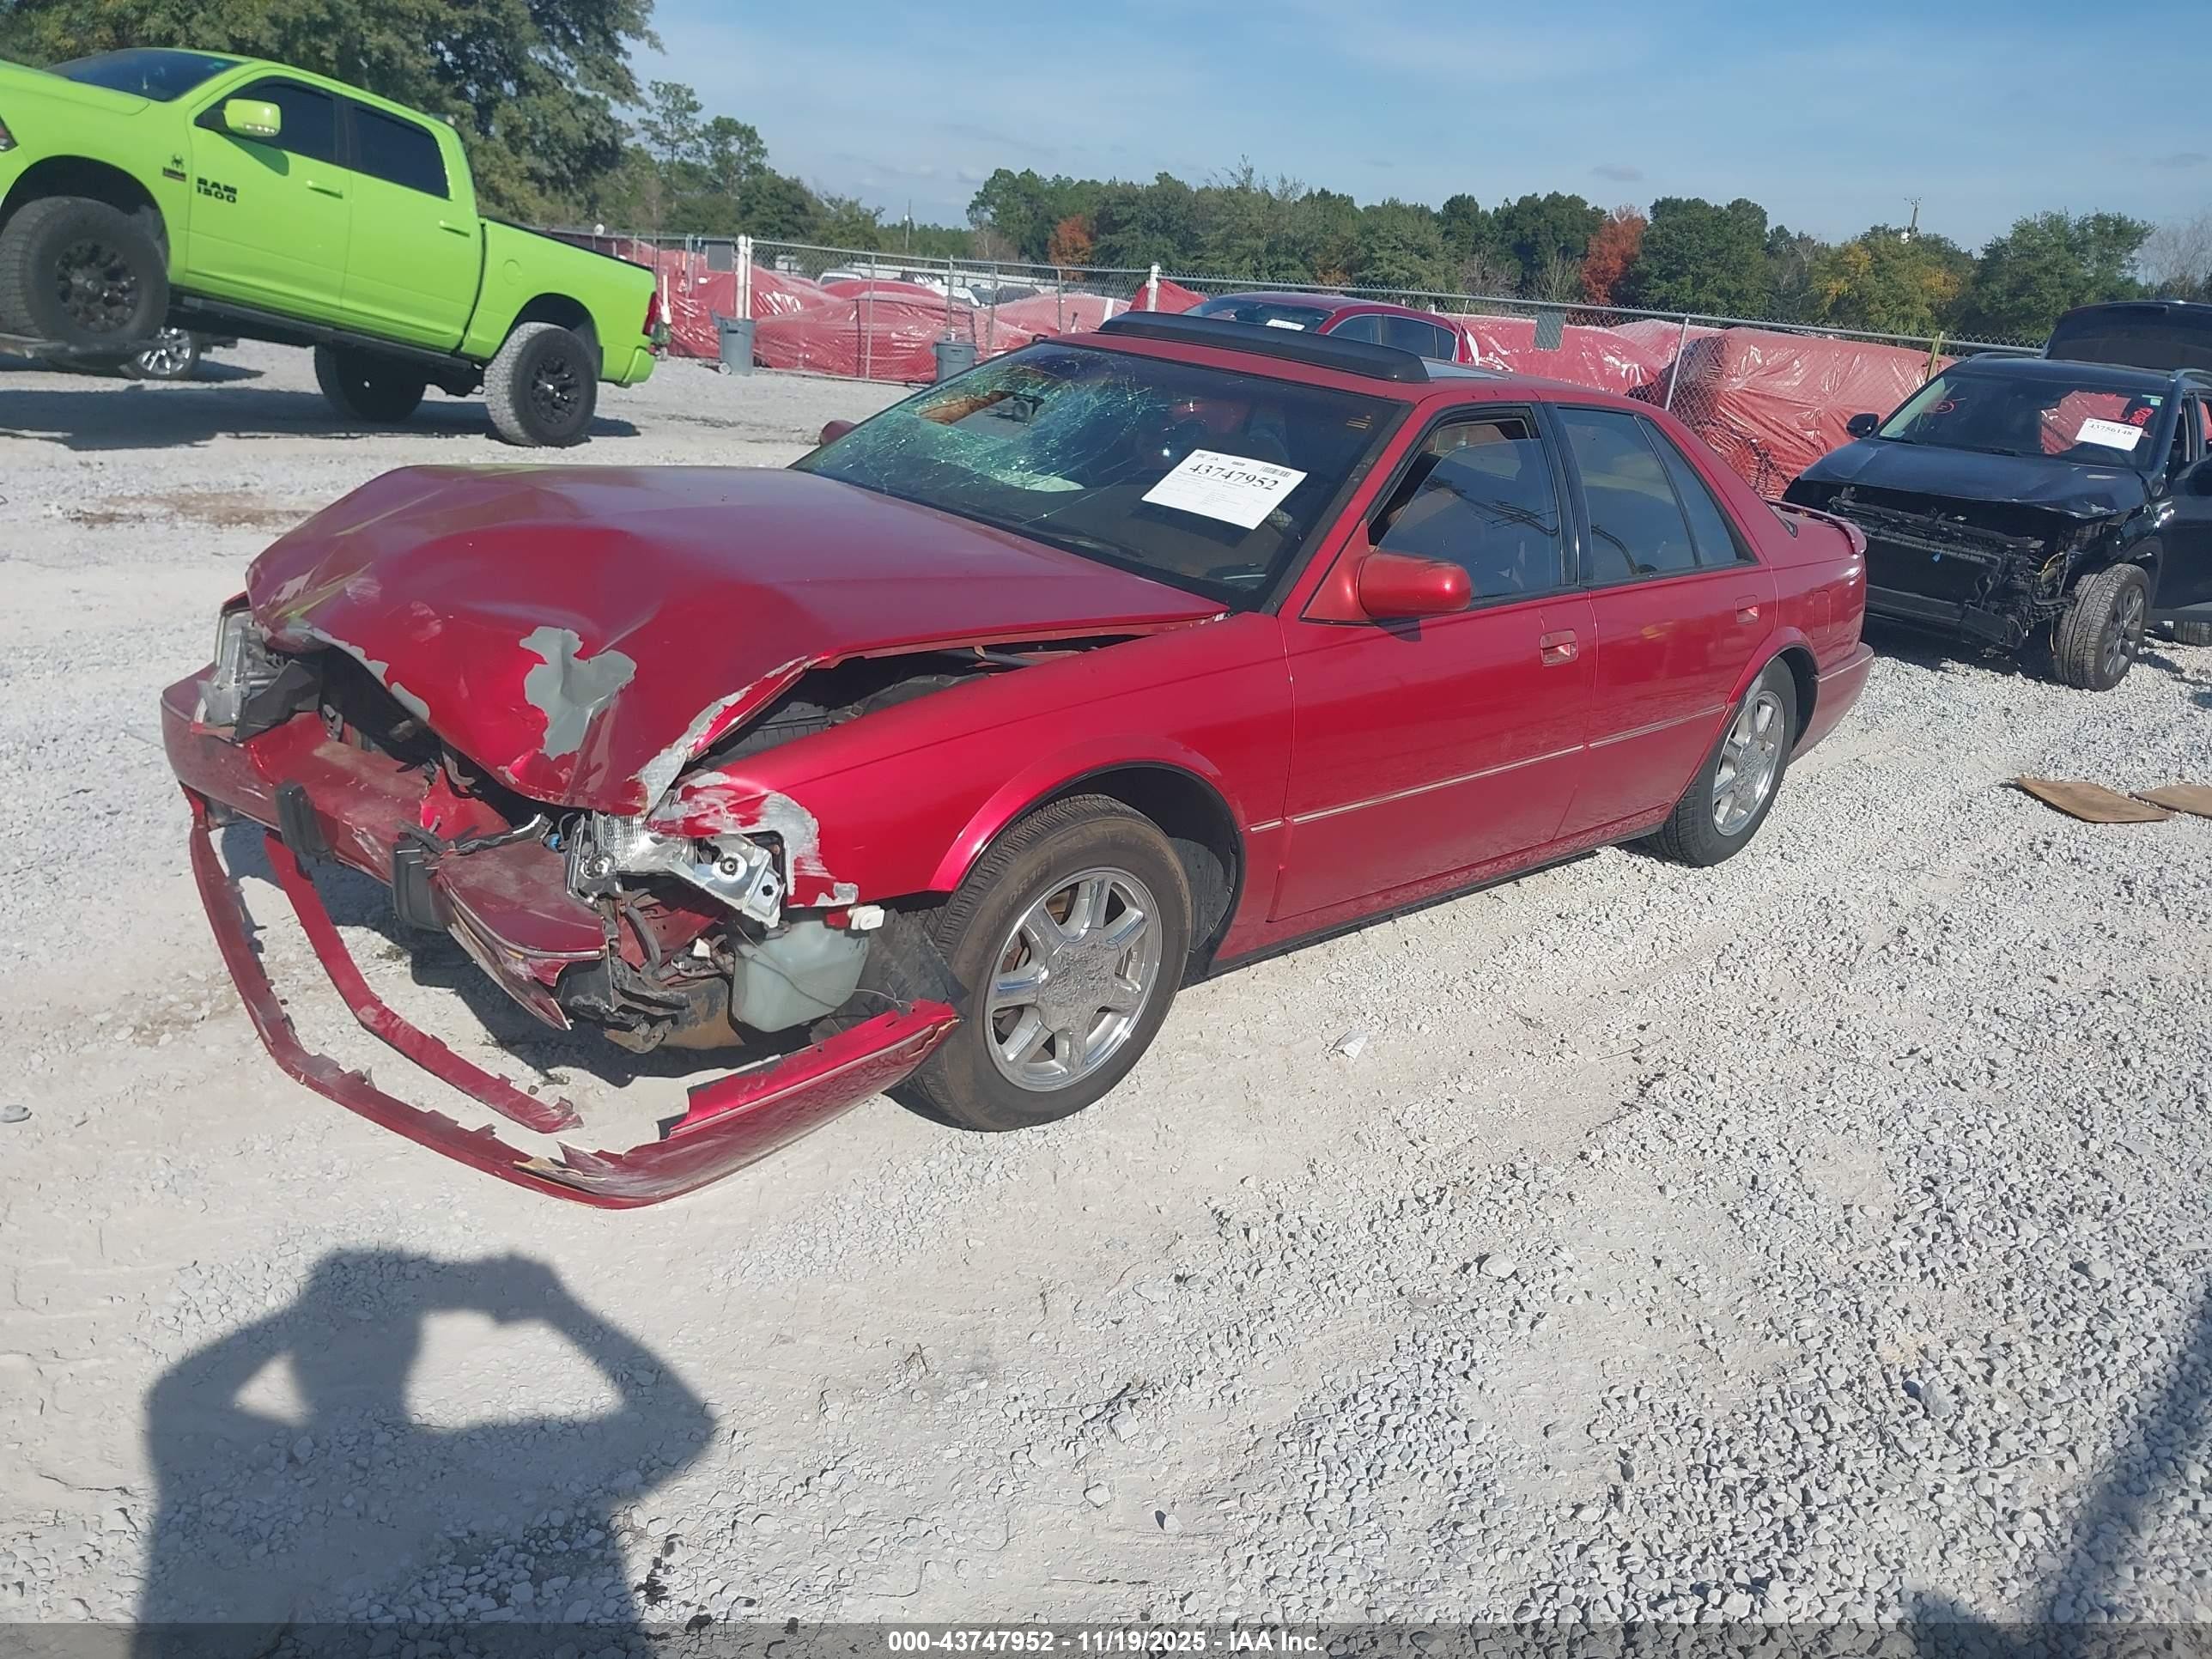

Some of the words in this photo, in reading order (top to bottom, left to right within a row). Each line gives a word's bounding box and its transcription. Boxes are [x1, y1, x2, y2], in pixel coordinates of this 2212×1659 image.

[197, 177, 237, 195] RAM
[197, 185, 236, 204] 1500
[1189, 463, 1279, 490] 43747952
